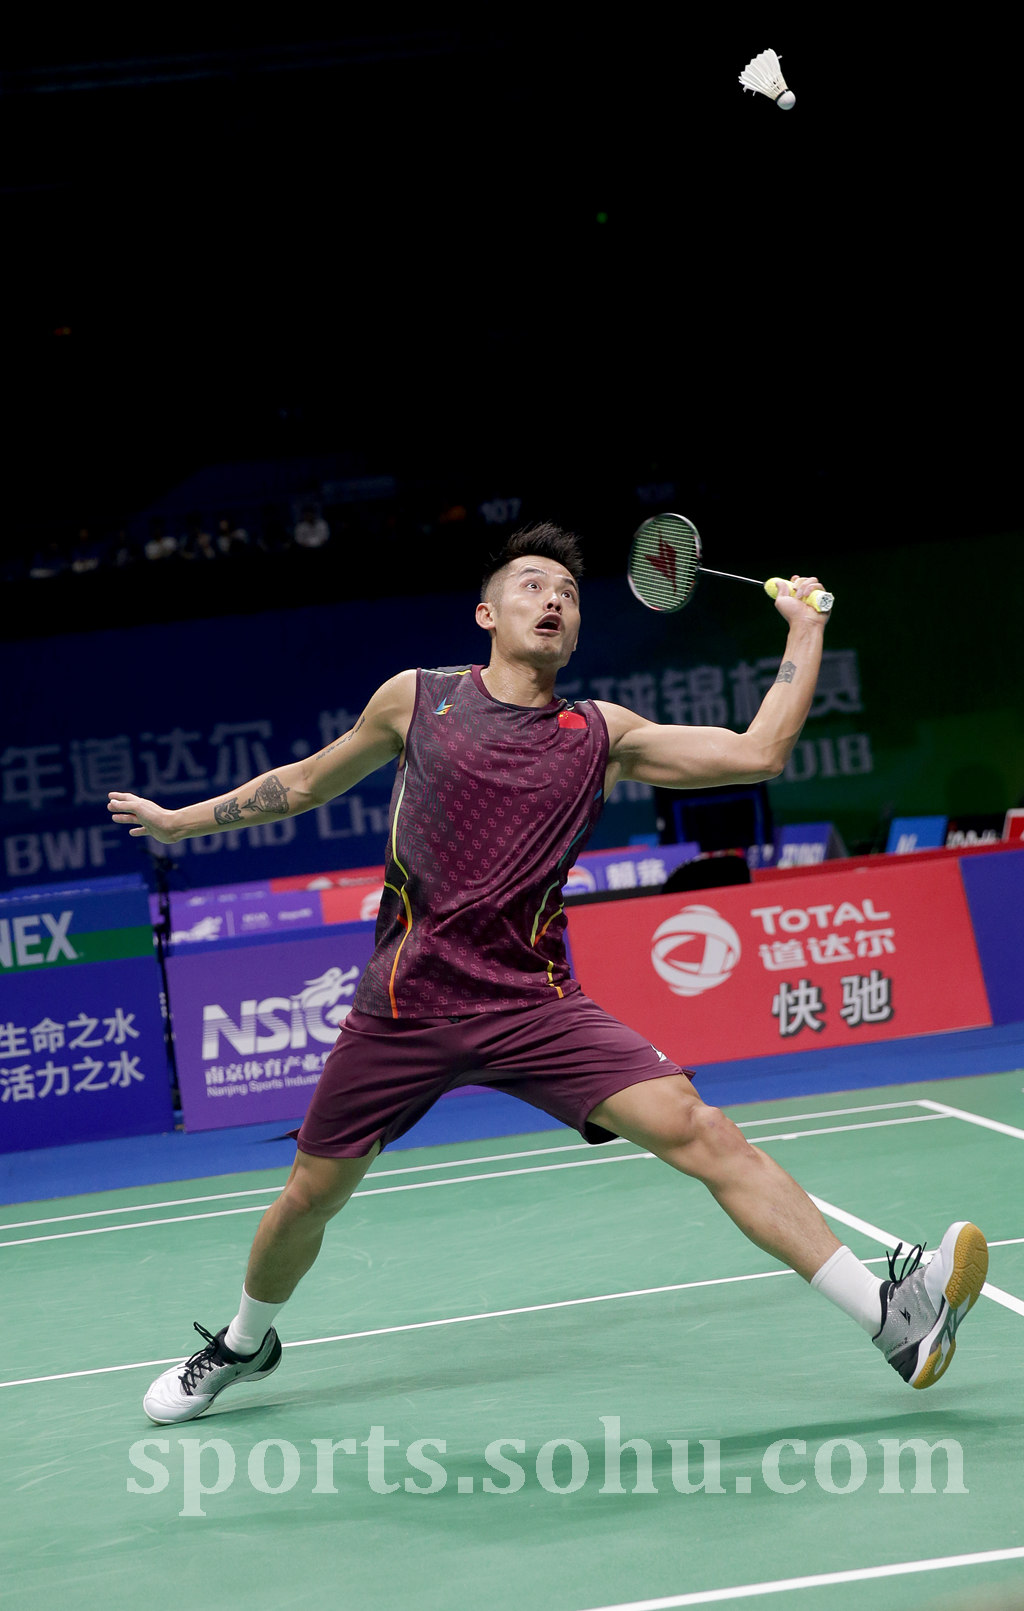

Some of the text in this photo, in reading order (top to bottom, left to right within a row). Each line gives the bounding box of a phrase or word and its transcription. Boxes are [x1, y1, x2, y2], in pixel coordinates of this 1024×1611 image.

[4, 824, 122, 877] BWF
[782, 734, 874, 783] 018
[750, 898, 891, 935] TOTAL
[758, 928, 896, 971] 道达尔
[0, 1008, 140, 1059] 生命之水
[0, 1051, 145, 1102] 活力之水
[207, 1083, 248, 1097] Nanjing
[249, 1078, 283, 1093] Sports
